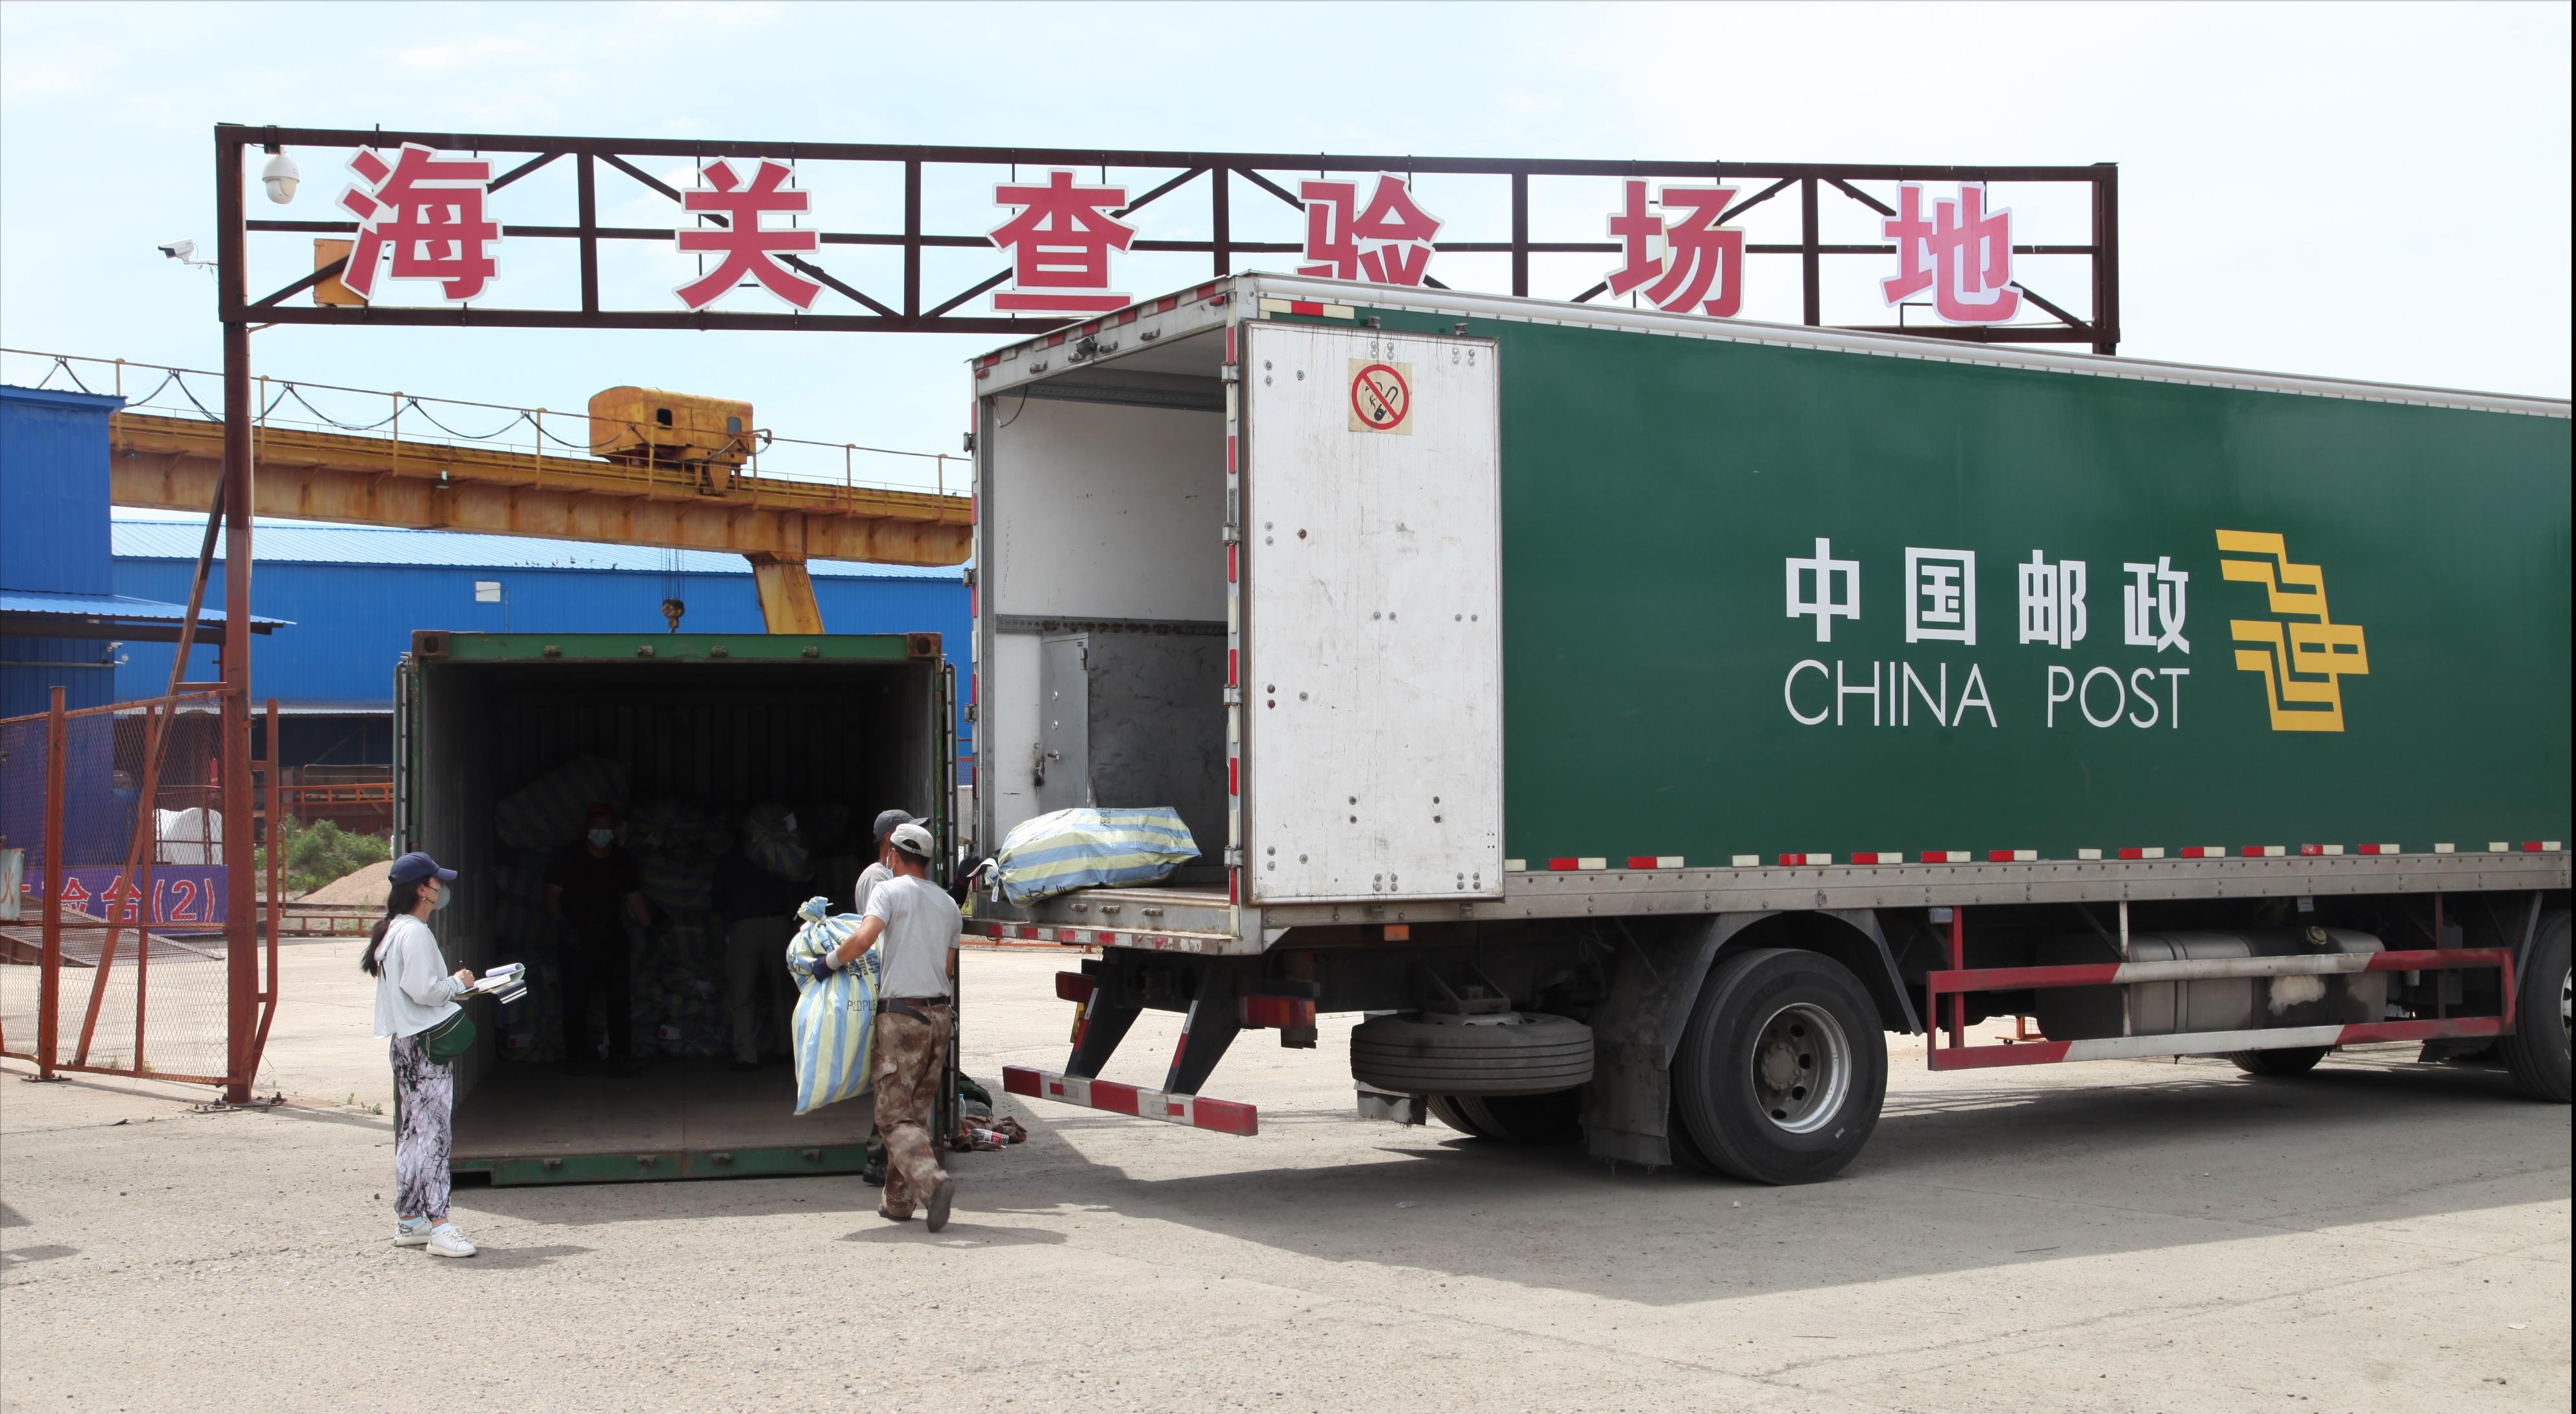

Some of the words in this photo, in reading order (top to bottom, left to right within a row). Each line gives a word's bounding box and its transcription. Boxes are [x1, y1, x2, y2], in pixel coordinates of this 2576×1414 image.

[342, 144, 2021, 324] 海关查验场地
[1785, 537, 2190, 654] 中国邮政
[1783, 658, 1998, 728] CHINA
[2047, 665, 2190, 729] POST
